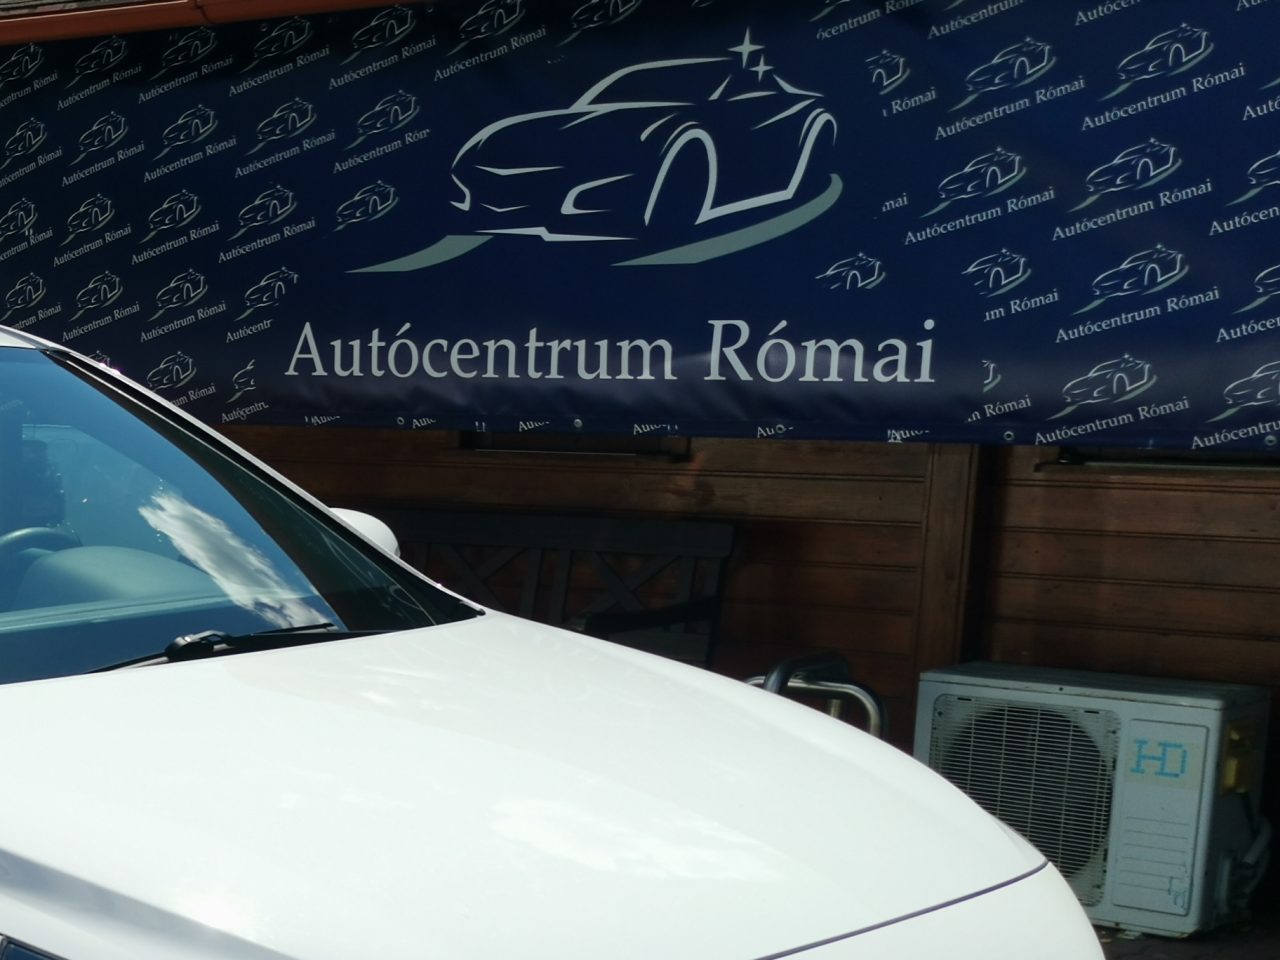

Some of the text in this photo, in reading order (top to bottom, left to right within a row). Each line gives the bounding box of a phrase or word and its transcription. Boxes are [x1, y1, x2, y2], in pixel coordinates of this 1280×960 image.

[816, 9, 881, 40] ócentrum
[228, 44, 330, 96] Autócentrum Római
[328, 35, 438, 90] Autócentrum Római
[433, 25, 547, 82] Autócentrum Római
[138, 55, 234, 104] Autócentrum Római
[891, 86, 937, 114] Római
[1081, 62, 1246, 131] Autócentrum Római
[934, 75, 1086, 141] Autócentrum Római
[37, 146, 63, 166] Római
[61, 140, 145, 187] Autócentrum Római
[143, 135, 238, 183] Autócentrum Római
[234, 128, 336, 178] Autócentrum Római
[332, 135, 403, 174] Autócentrum
[882, 192, 908, 212] mai
[904, 186, 1056, 245] Autócentrum Római
[1052, 178, 1212, 241] Autócentrum Római
[1209, 206, 1280, 236] Autócen
[53, 224, 132, 268] Autócentrum Római
[131, 220, 220, 265] Autócentrum Római
[218, 217, 316, 264] Autócentrum Római
[37, 302, 62, 321] Római
[62, 316, 113, 342] Autócentrum
[113, 301, 140, 321] Római
[140, 300, 227, 343] Autócentrum Római
[1009, 288, 1060, 314] Római
[1056, 285, 1220, 343] Autócentrum Római
[225, 319, 274, 343] Autócentr
[284, 318, 936, 383] Autócentrum Római
[1216, 315, 1280, 343] Autóce
[188, 382, 217, 402] Római
[983, 394, 1033, 418] Római
[1034, 396, 1190, 445] Autócentrum Római
[1191, 420, 1280, 450] Autócentru
